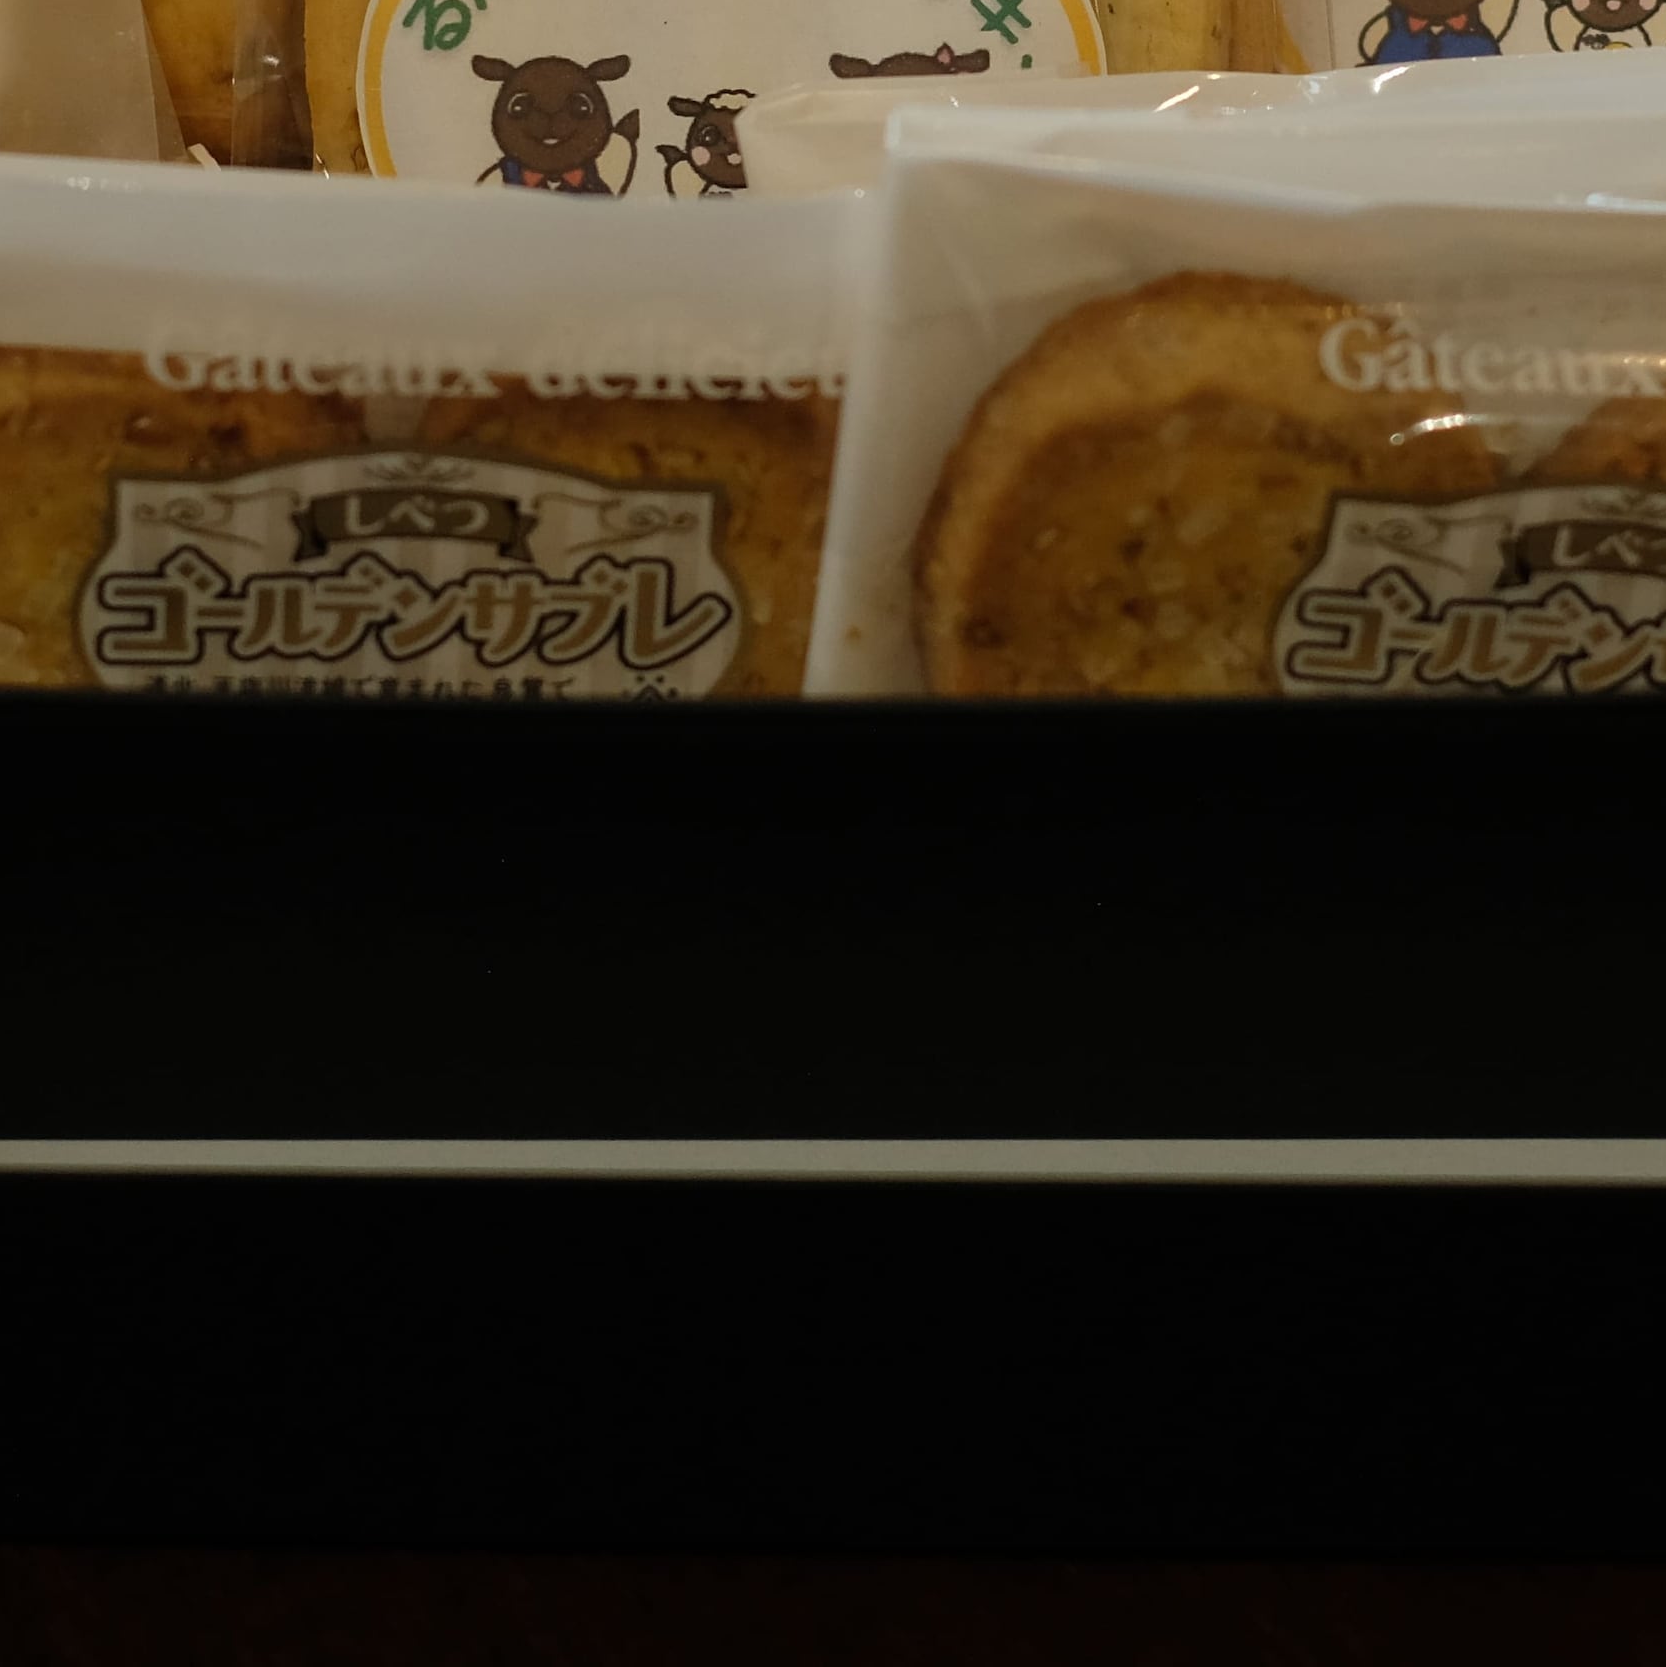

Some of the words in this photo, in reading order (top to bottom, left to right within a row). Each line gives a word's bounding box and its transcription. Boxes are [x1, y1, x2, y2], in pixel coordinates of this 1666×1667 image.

[1319, 316, 1666, 399] Gâteaux
[345, 493, 490, 536] しべつ
[98, 546, 731, 667] ゴールデンサブレ
